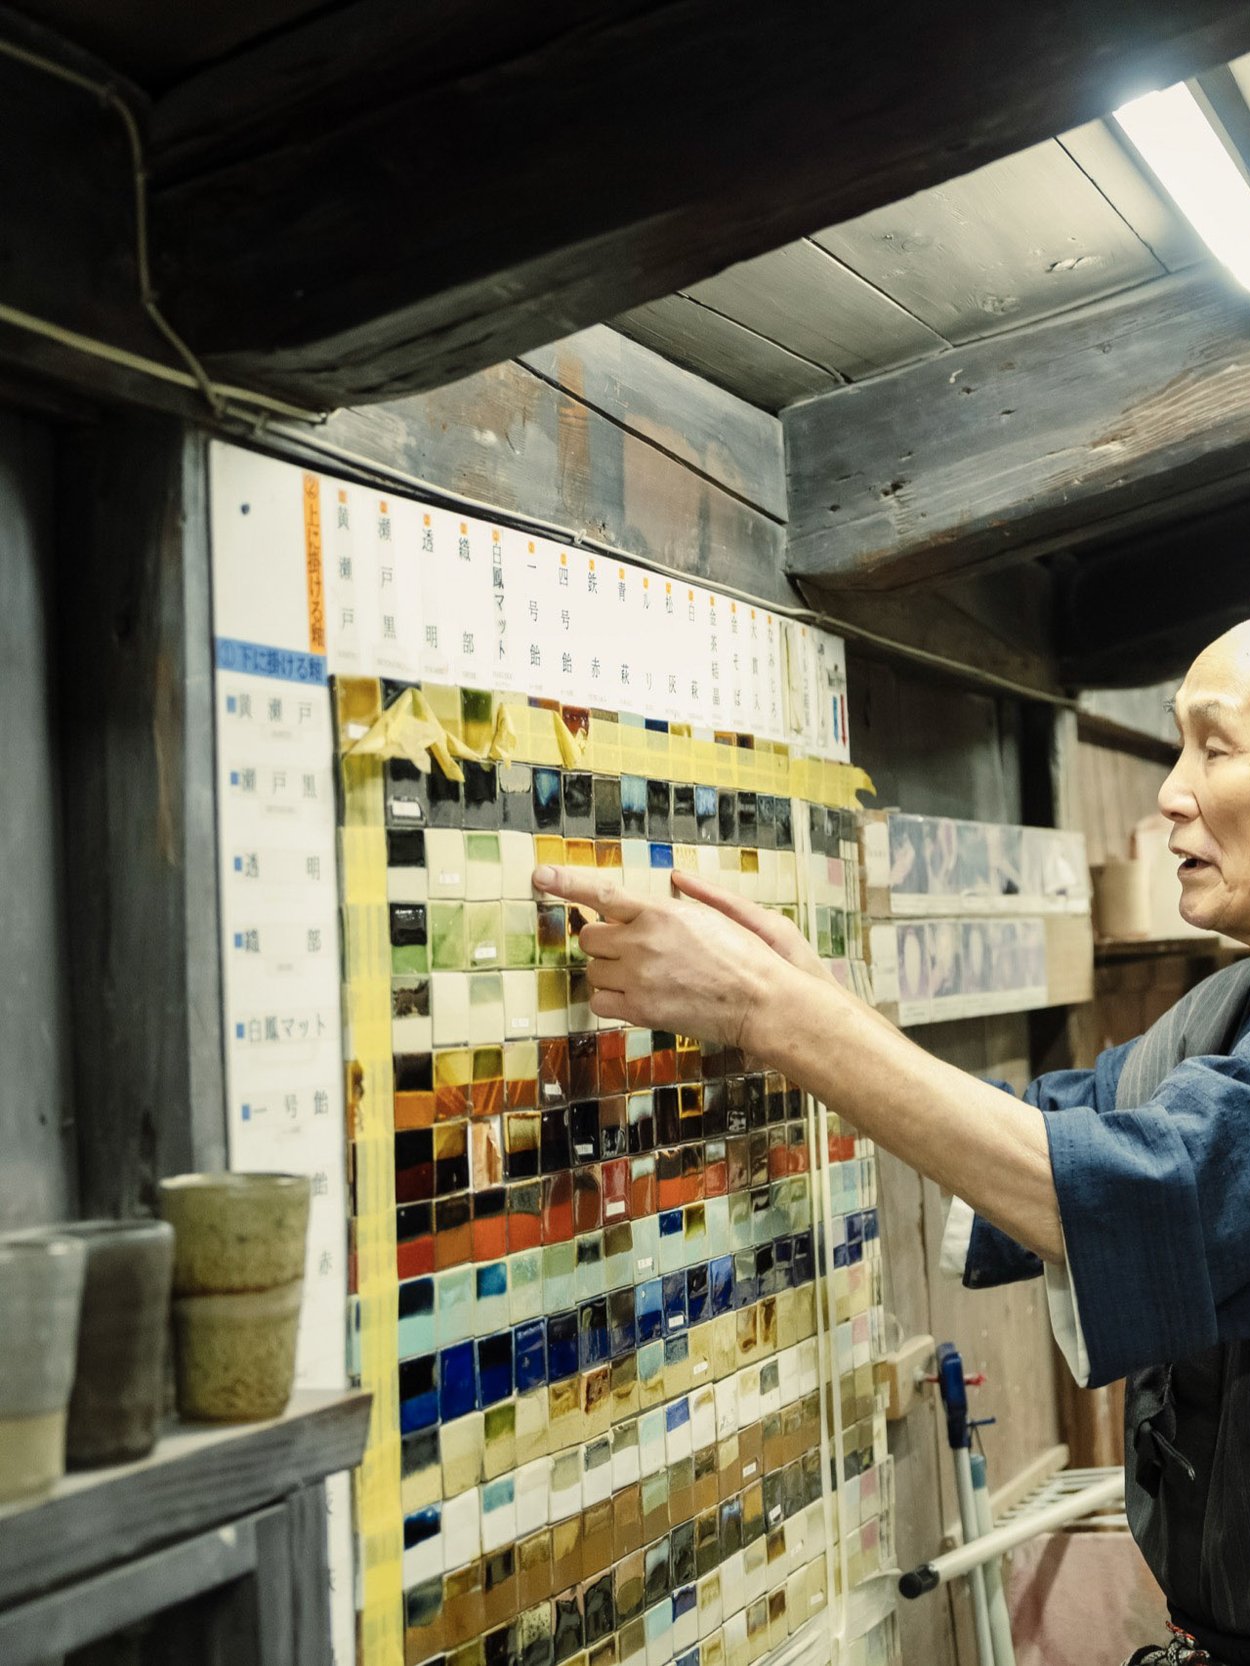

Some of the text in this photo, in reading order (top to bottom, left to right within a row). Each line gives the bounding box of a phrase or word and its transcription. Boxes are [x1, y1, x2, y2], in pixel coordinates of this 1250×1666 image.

[337, 506, 354, 630] 黄瀬戸
[378, 518, 396, 640] 瀬戸黒
[422, 528, 438, 649] 透明
[458, 537, 475, 655] 織部
[527, 563, 541, 666] 一号飴
[559, 567, 573, 673] 四号飴
[618, 581, 630, 685] 青萩
[239, 693, 313, 724] 黄瀬戸
[241, 768, 317, 798] 瀬戸黒
[245, 853, 321, 881] 透明
[245, 928, 322, 954] 織部
[253, 1089, 330, 1120] 一号飴
[317, 1249, 333, 1277] 赤
